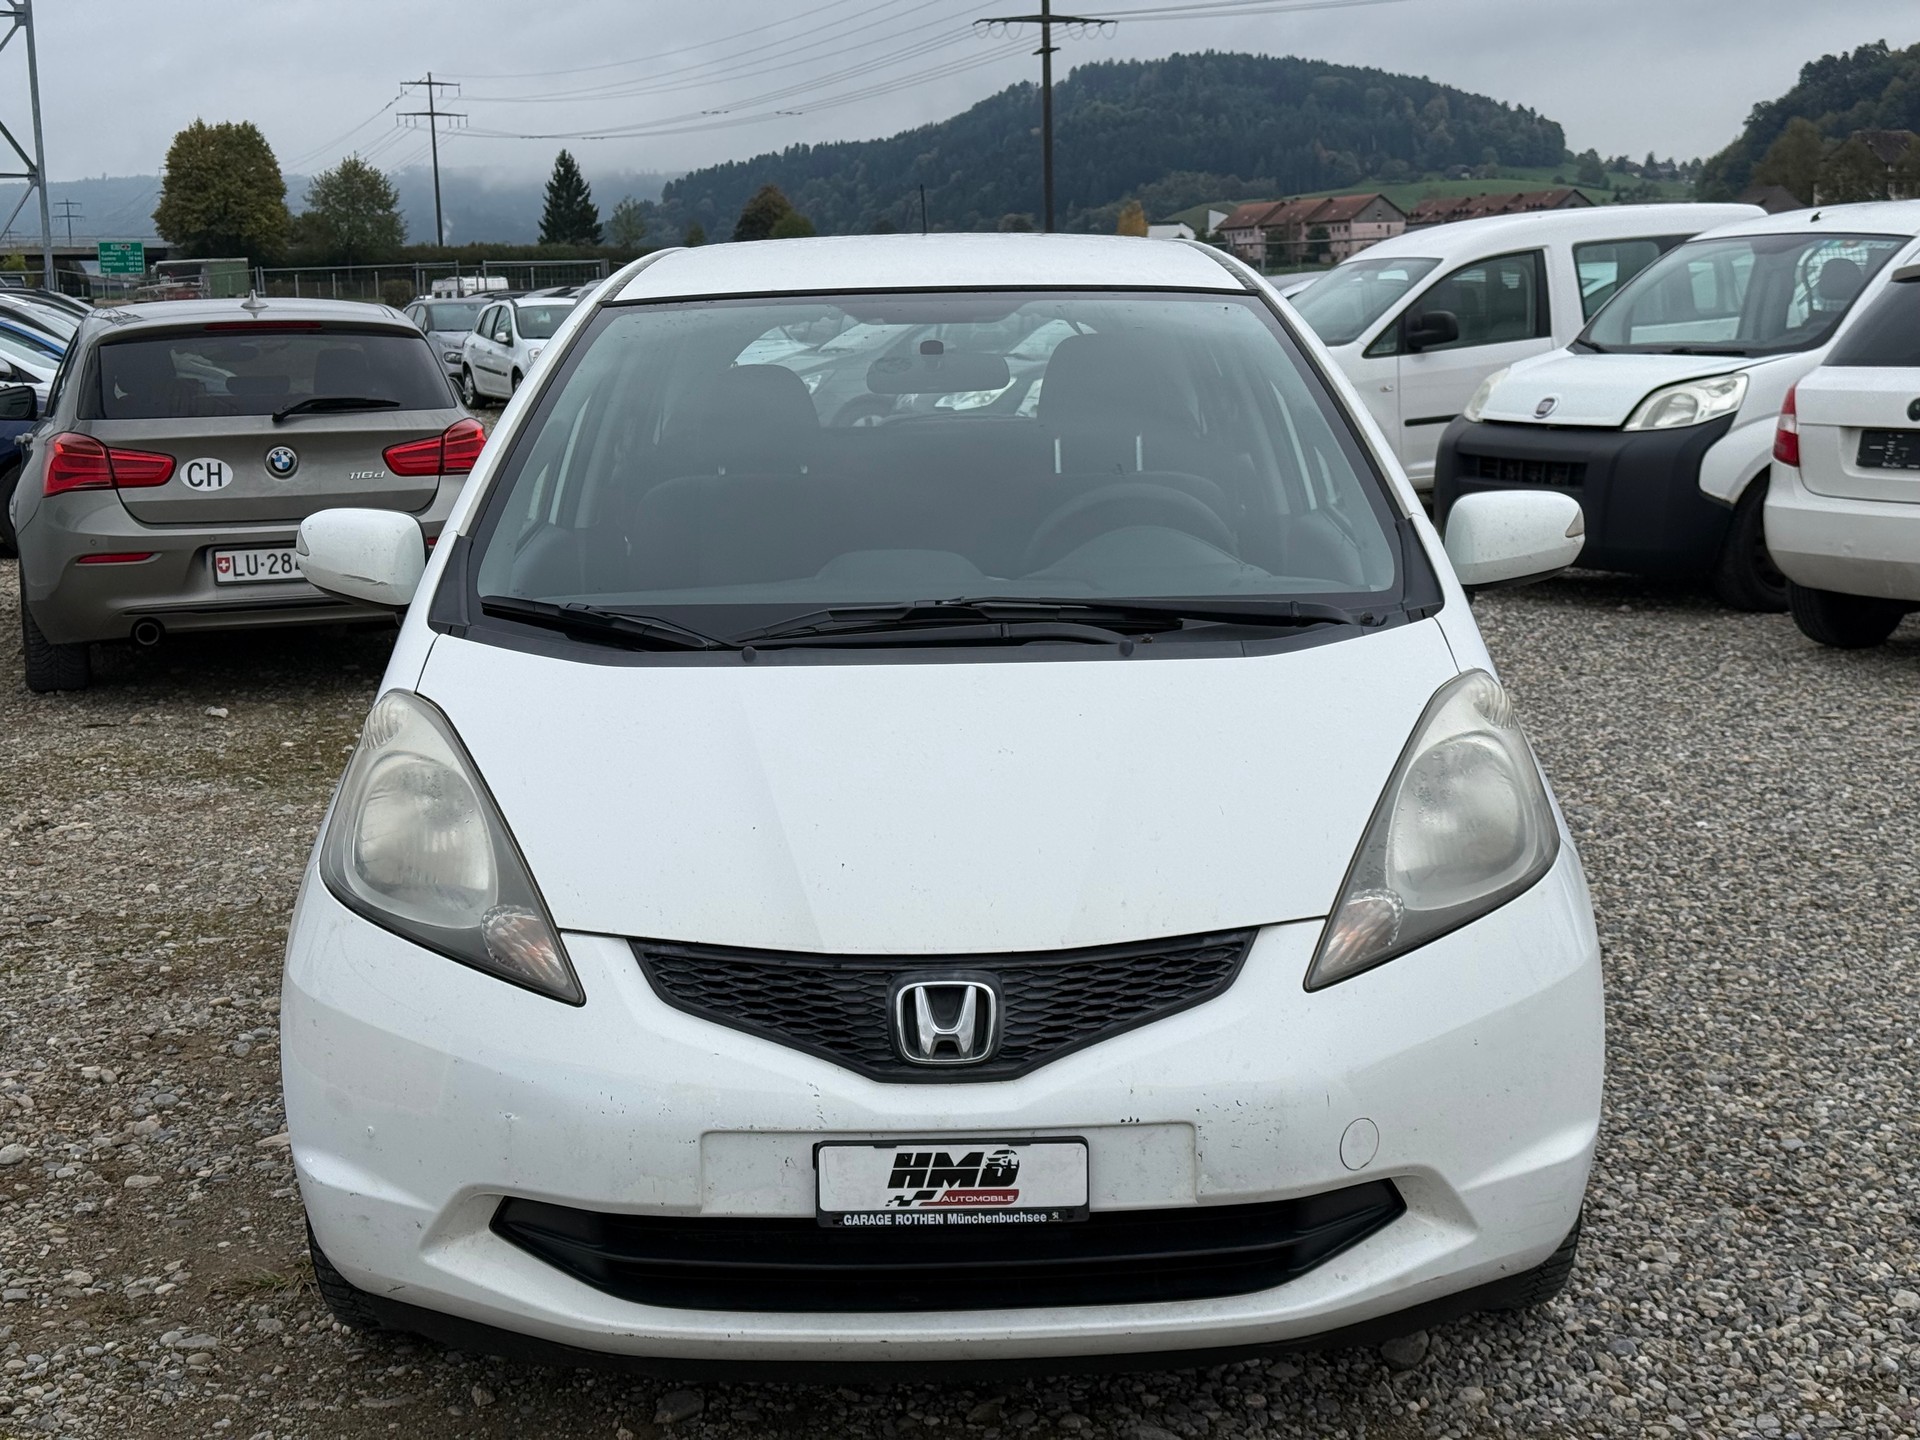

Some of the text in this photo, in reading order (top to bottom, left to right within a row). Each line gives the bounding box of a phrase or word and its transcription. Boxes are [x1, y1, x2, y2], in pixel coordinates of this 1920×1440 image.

[187, 462, 223, 488] CH
[941, 1195, 1015, 1203] AUTOMOBILE
[843, 1212, 1047, 1225] GARAGE ROTHEN Münchenbuchsee
